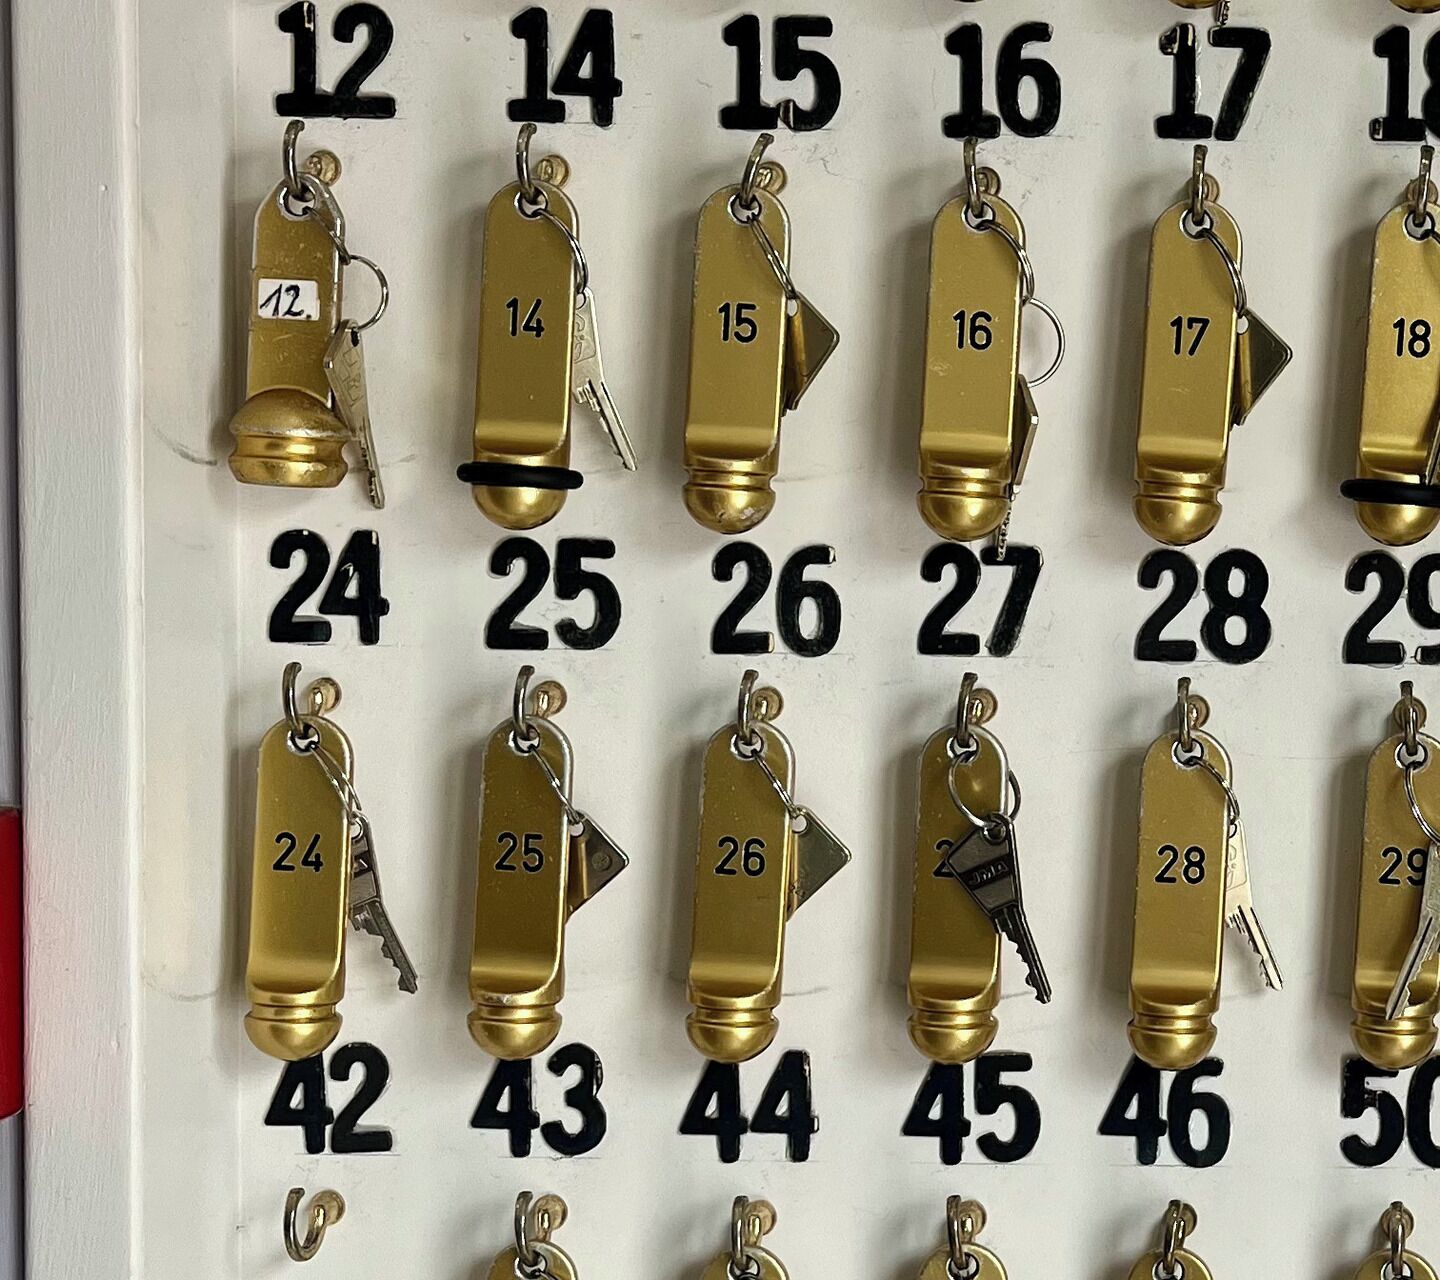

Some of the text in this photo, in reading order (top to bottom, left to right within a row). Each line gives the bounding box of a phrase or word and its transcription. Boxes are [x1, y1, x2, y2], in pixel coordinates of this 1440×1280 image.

[276, 1, 396, 118] 12
[506, 7, 622, 127] 14
[720, 14, 841, 131] 15
[943, 22, 1061, 138] 16
[1156, 24, 1271, 141] 17
[506, 298, 545, 338] 14
[719, 302, 758, 343] 15
[952, 310, 992, 351] 16
[1170, 316, 1210, 356] 17
[1392, 318, 1431, 358] 18
[268, 528, 389, 645] 24
[486, 536, 621, 650] 25
[711, 541, 842, 656] 26
[919, 544, 1044, 657] 27
[1136, 548, 1272, 663] 28
[272, 832, 324, 873] 24
[494, 832, 544, 873] 25
[714, 836, 766, 877] 26
[932, 838, 955, 879] 2
[970, 861, 1009, 885] JMA
[1155, 844, 1206, 884] 28
[1379, 846, 1426, 886] 29
[264, 1041, 391, 1154] 42
[470, 1043, 606, 1158] 43
[679, 1049, 819, 1163] 44
[902, 1051, 1041, 1165] 45
[1098, 1054, 1229, 1168] 46
